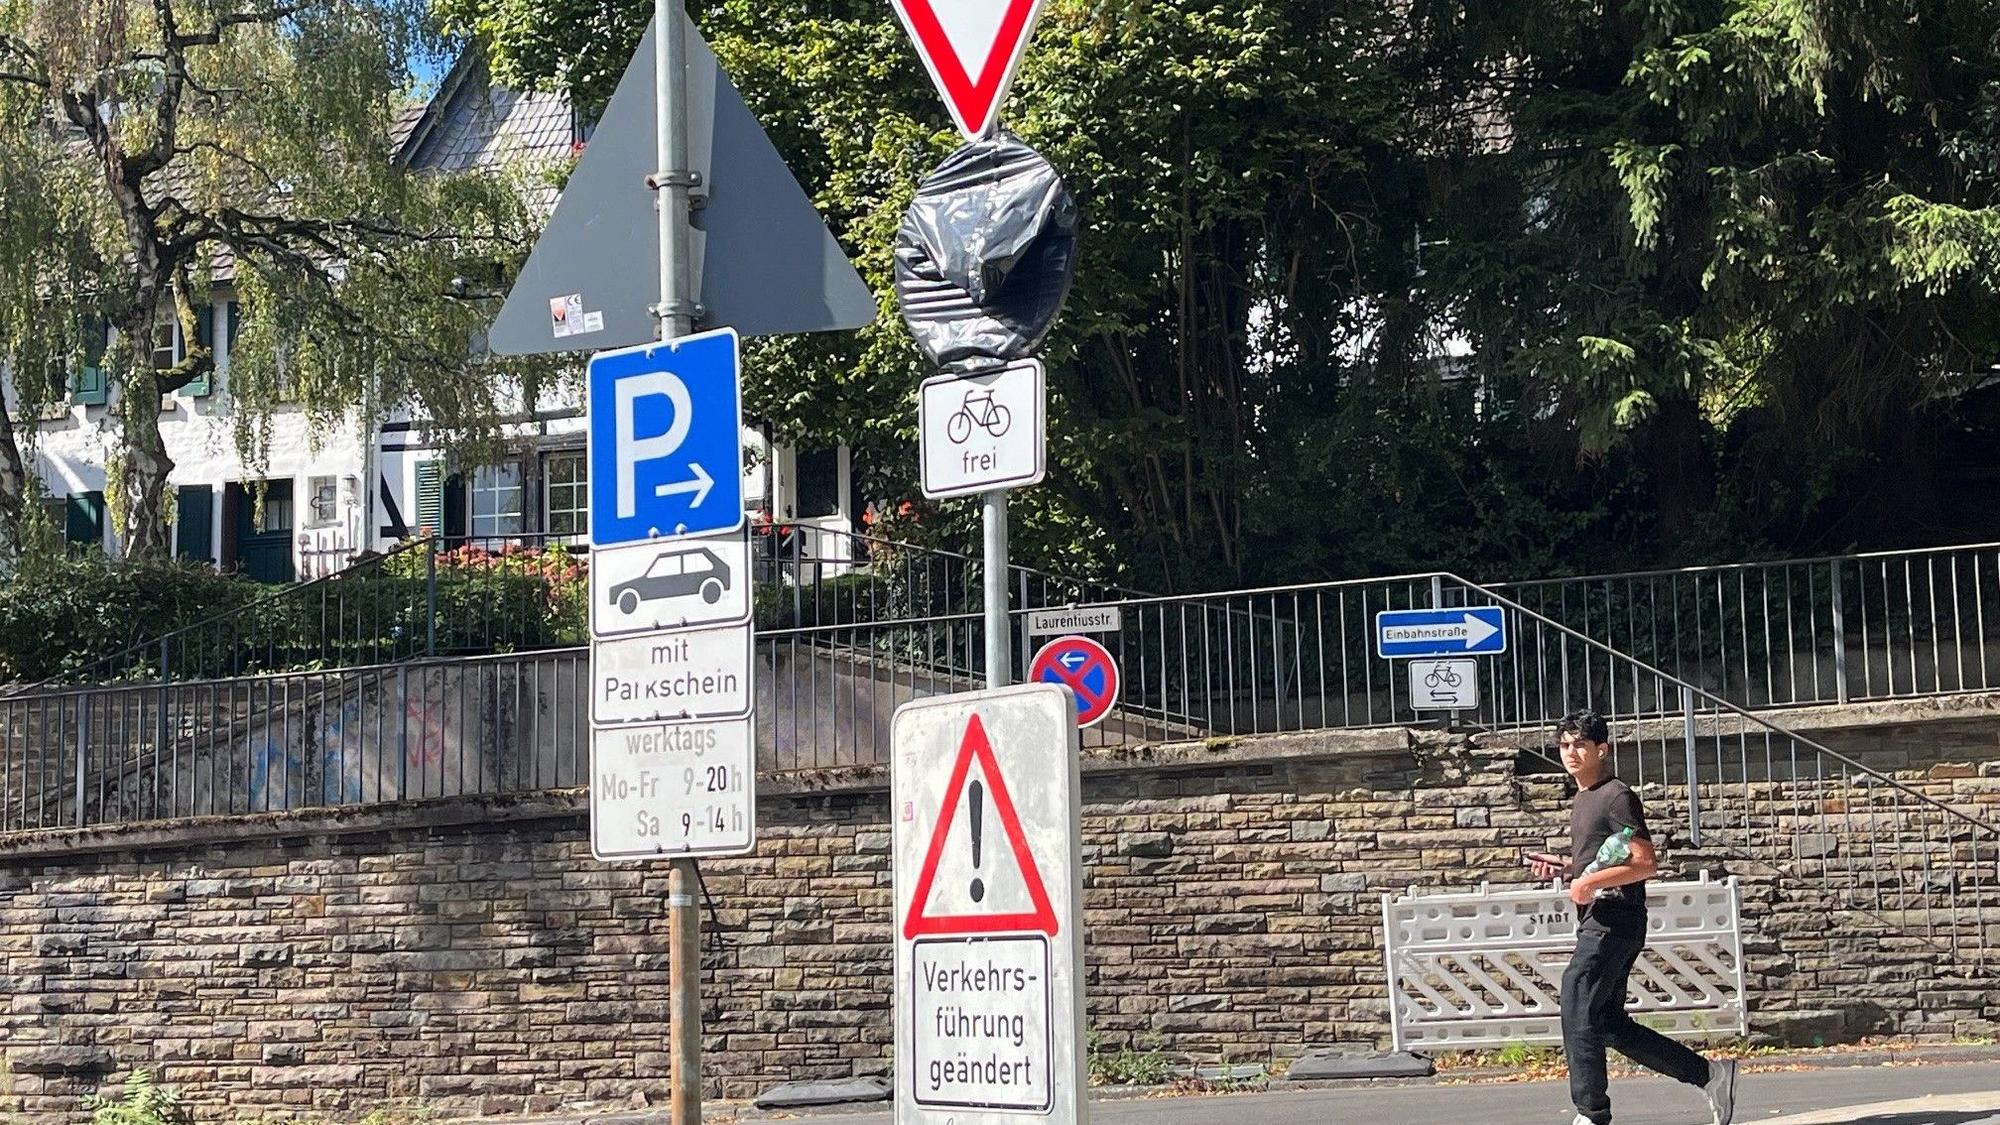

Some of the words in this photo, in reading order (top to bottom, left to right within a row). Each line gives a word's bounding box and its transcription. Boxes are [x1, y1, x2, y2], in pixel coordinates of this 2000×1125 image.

[614, 371, 693, 519] P
[962, 446, 997, 474] frei
[1386, 626, 1468, 640] Einbahnstraße
[651, 638, 689, 664] mit
[626, 725, 717, 757] werktags
[601, 769, 660, 801] Mo-Fr
[636, 809, 660, 838] Sa
[1529, 912, 1570, 925] STADT
[922, 961, 1038, 992] Verkehrs-
[935, 1006, 1024, 1046] führung
[930, 1051, 1033, 1091] geändert
